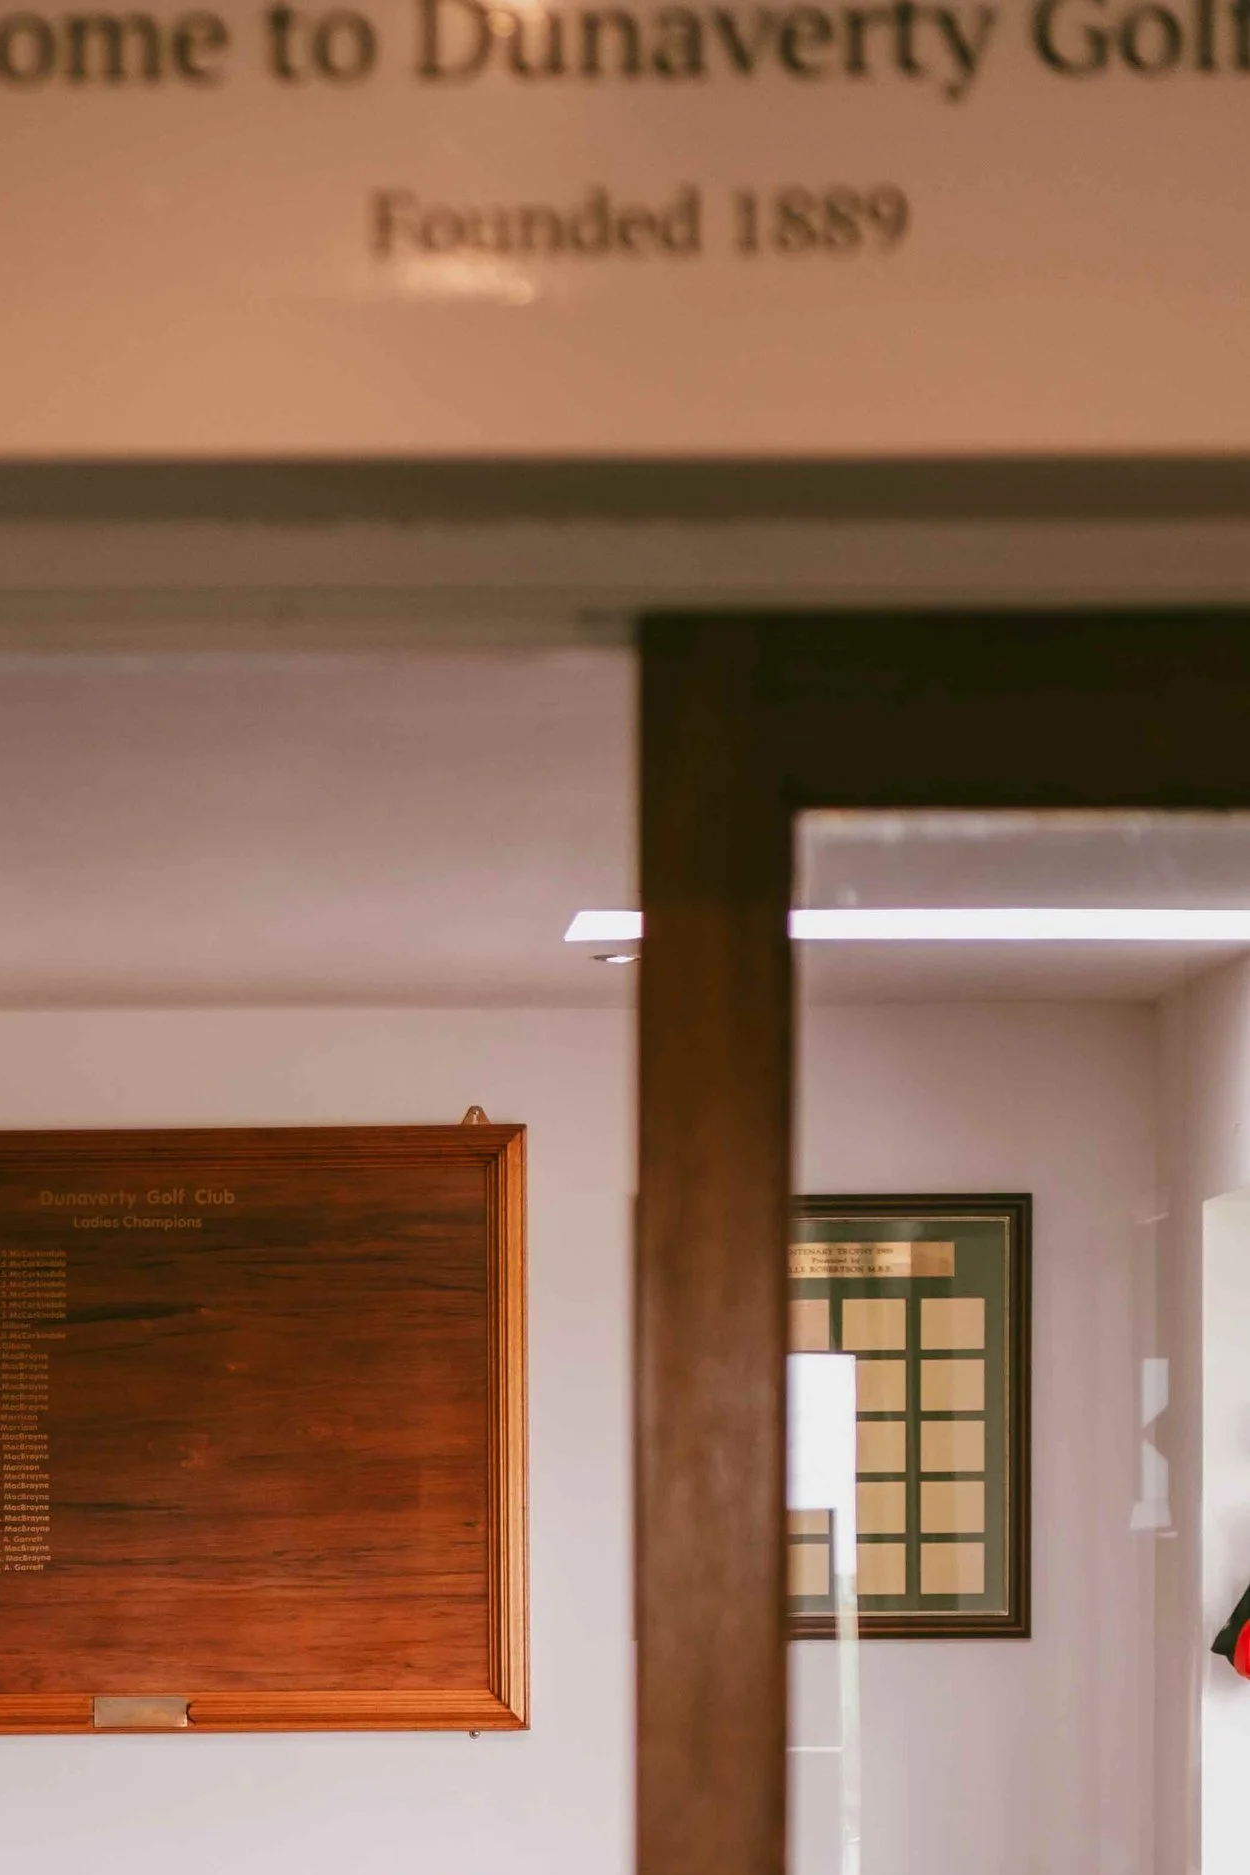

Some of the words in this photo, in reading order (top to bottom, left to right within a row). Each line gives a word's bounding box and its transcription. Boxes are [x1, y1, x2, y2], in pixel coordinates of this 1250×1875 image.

[265, 2, 380, 86] to
[413, 0, 998, 104] Dunaverty
[370, 186, 702, 258] Founded
[735, 184, 910, 256] 1889
[39, 1189, 137, 1209] Dunaverty
[145, 1188, 187, 1205] Golf
[193, 1188, 235, 1205] Club
[73, 1215, 120, 1229] Ladies
[122, 1215, 203, 1232] Champions
